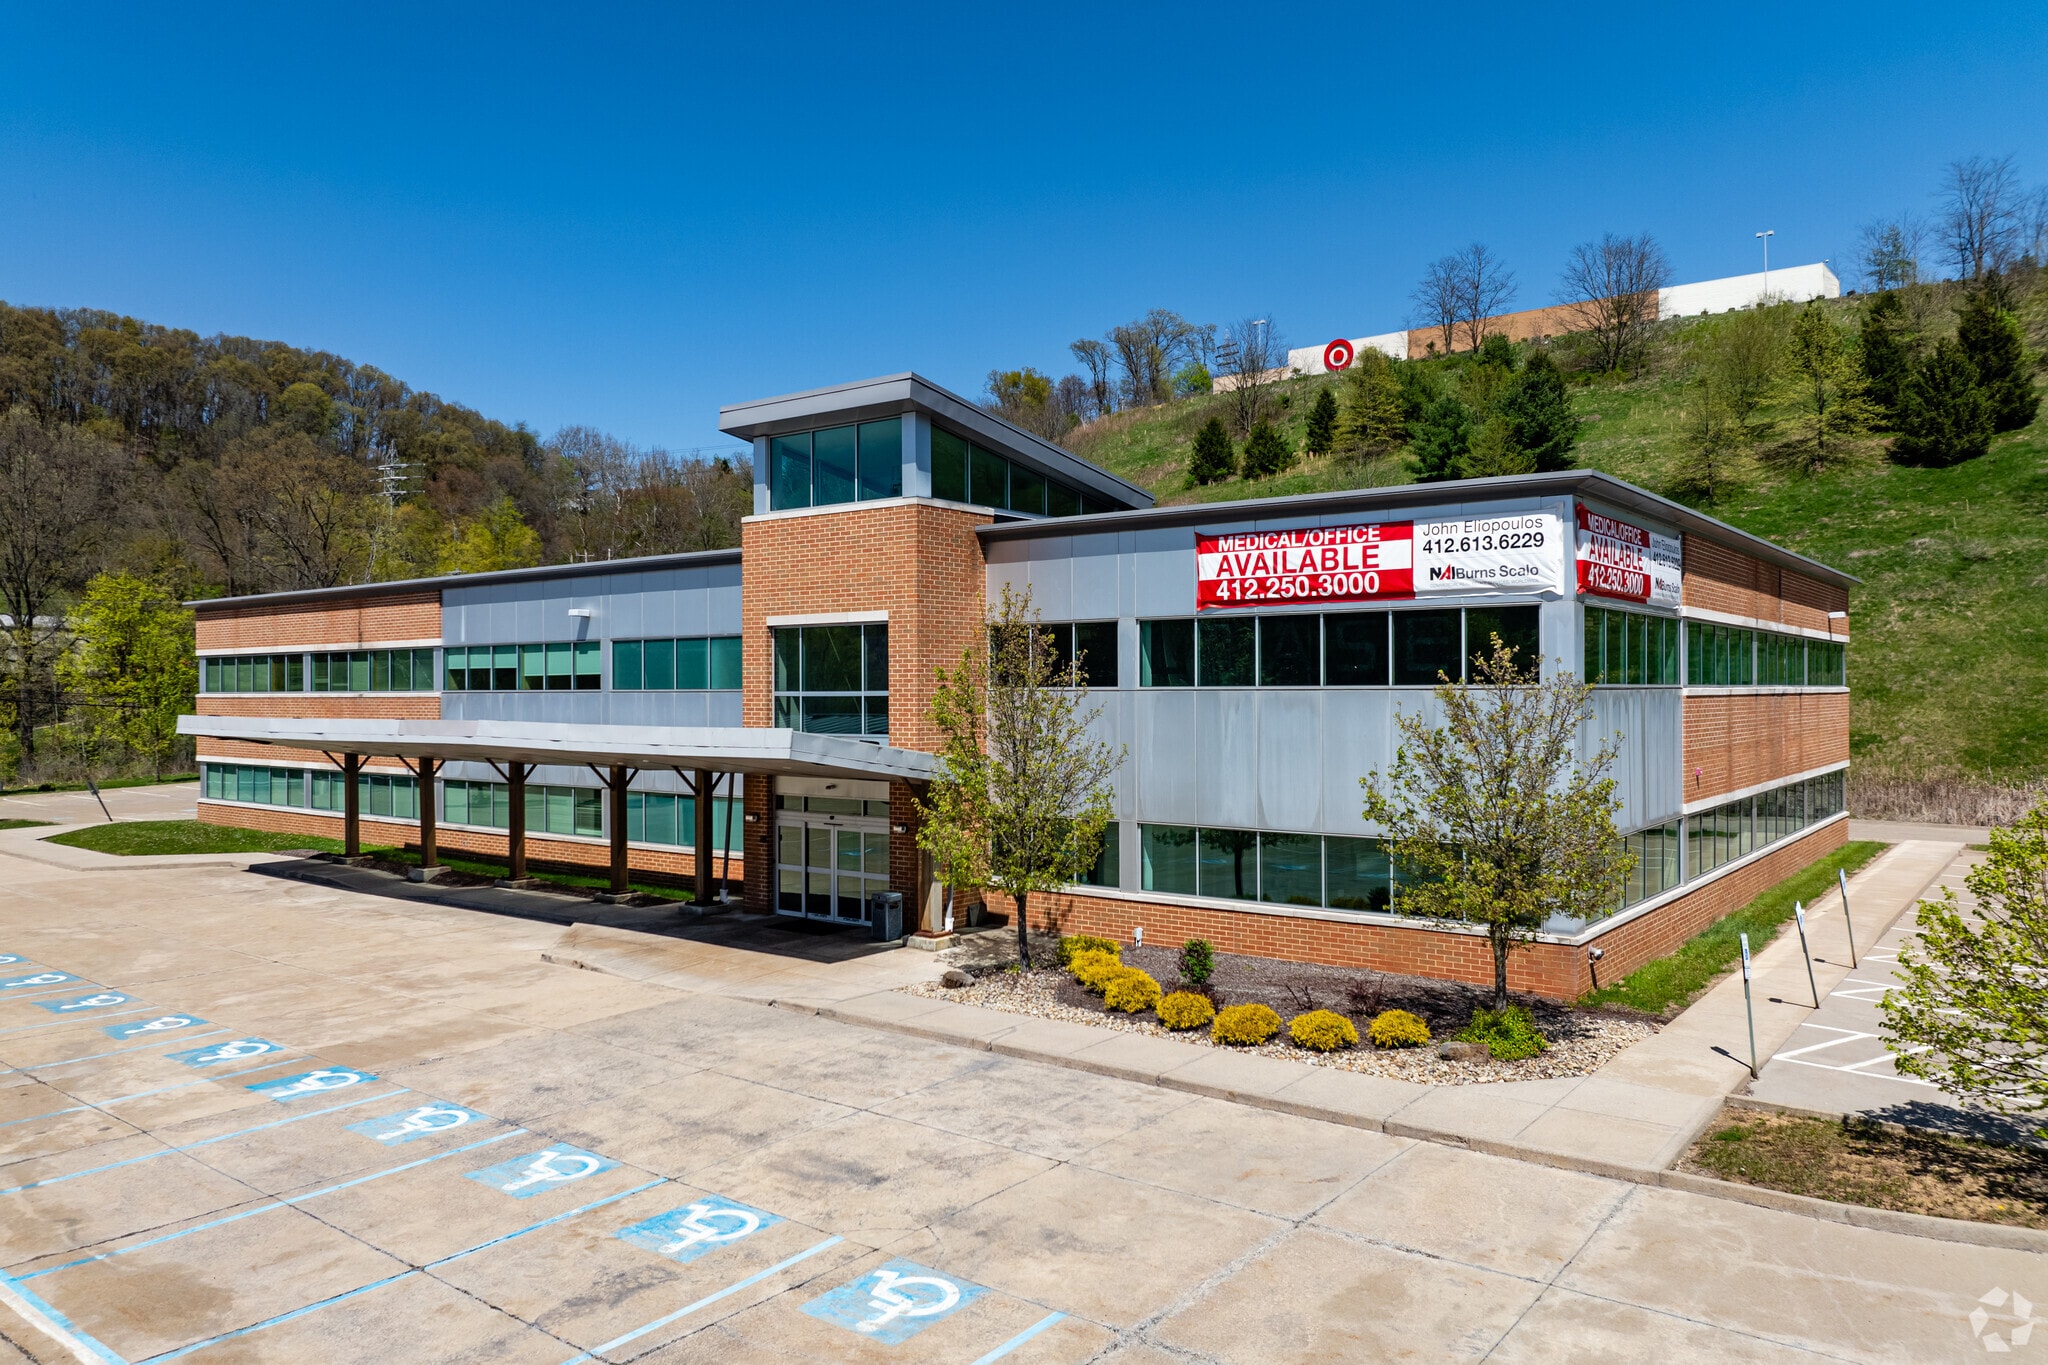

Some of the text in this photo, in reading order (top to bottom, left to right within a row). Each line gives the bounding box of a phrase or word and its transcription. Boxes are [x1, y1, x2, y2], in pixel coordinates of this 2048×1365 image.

[1218, 525, 1381, 552] MEDICAL/OFFICE
[1423, 517, 1543, 536] John Eliopoulos
[1588, 513, 1642, 545] MEDICAL/OFFICE
[1423, 532, 1545, 554] 412.613.6229
[1589, 534, 1644, 571] AVAILABLE
[1216, 545, 1380, 577] AVAILABLE
[1499, 564, 1539, 577] Scalo
[1216, 572, 1380, 600] 412.250.3000
[1588, 564, 1644, 595] 412.250.3000
